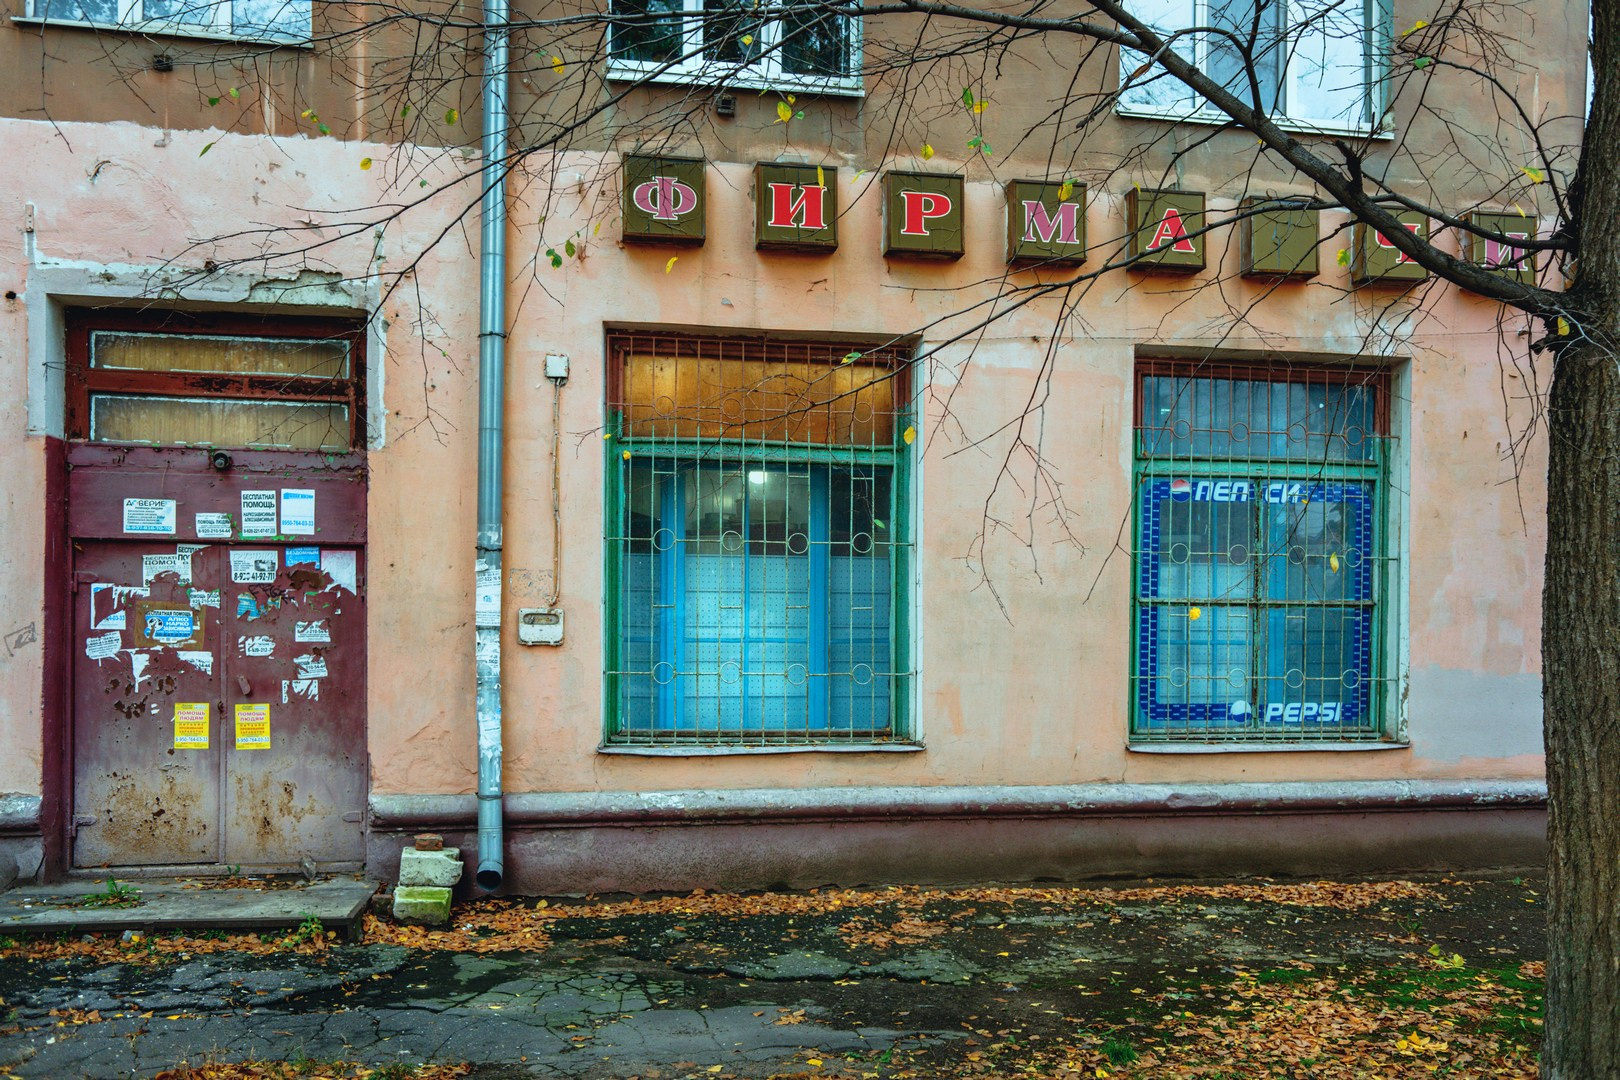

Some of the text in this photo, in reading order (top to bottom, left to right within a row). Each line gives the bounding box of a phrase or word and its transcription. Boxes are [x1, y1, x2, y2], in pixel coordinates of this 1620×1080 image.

[632, 175, 1196, 254] ФИРМА
[243, 501, 275, 509] ПОМОЩЬ
[1265, 702, 1343, 722] PEPSI
